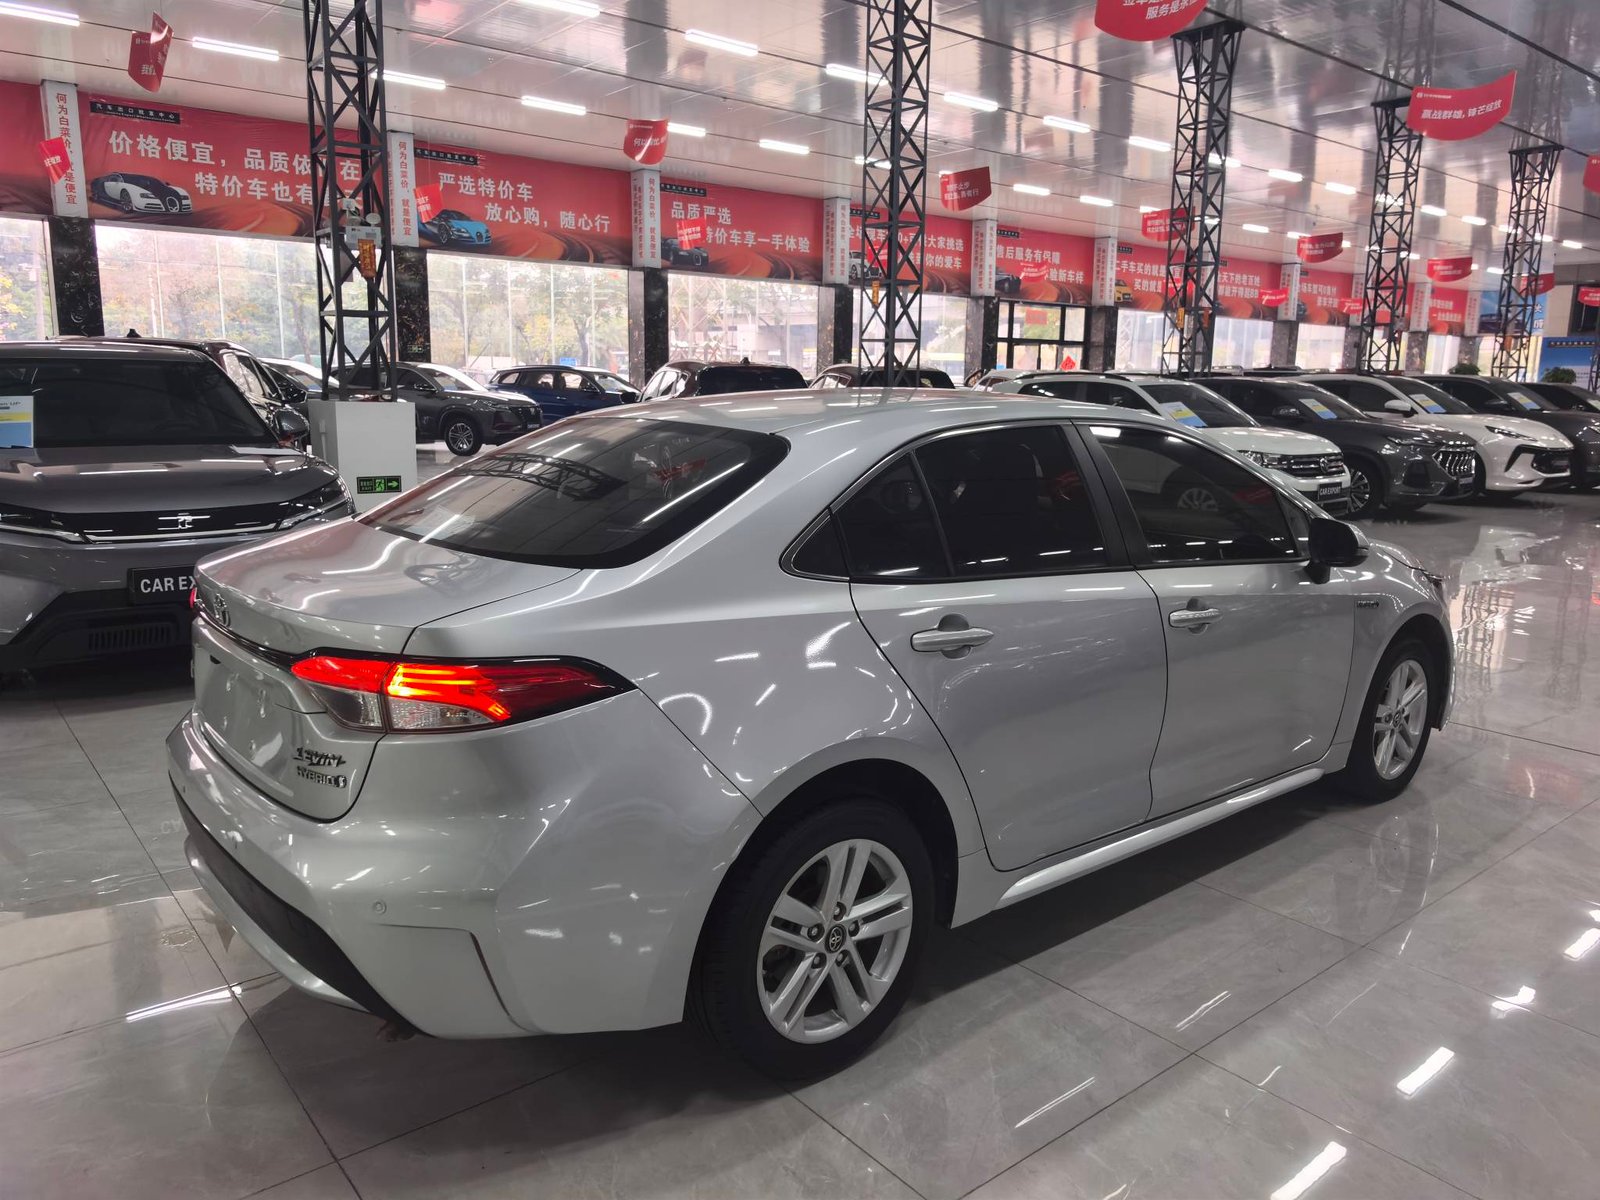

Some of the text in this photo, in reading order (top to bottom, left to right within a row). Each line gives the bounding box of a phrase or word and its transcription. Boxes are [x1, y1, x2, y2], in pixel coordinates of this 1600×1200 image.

[56, 93, 78, 205] 何为白菜价，是便宜
[438, 171, 534, 202] 严选特价车
[484, 202, 611, 233] 放心购，随心行
[671, 200, 732, 226] 品质严选
[140, 577, 174, 593] CAR
